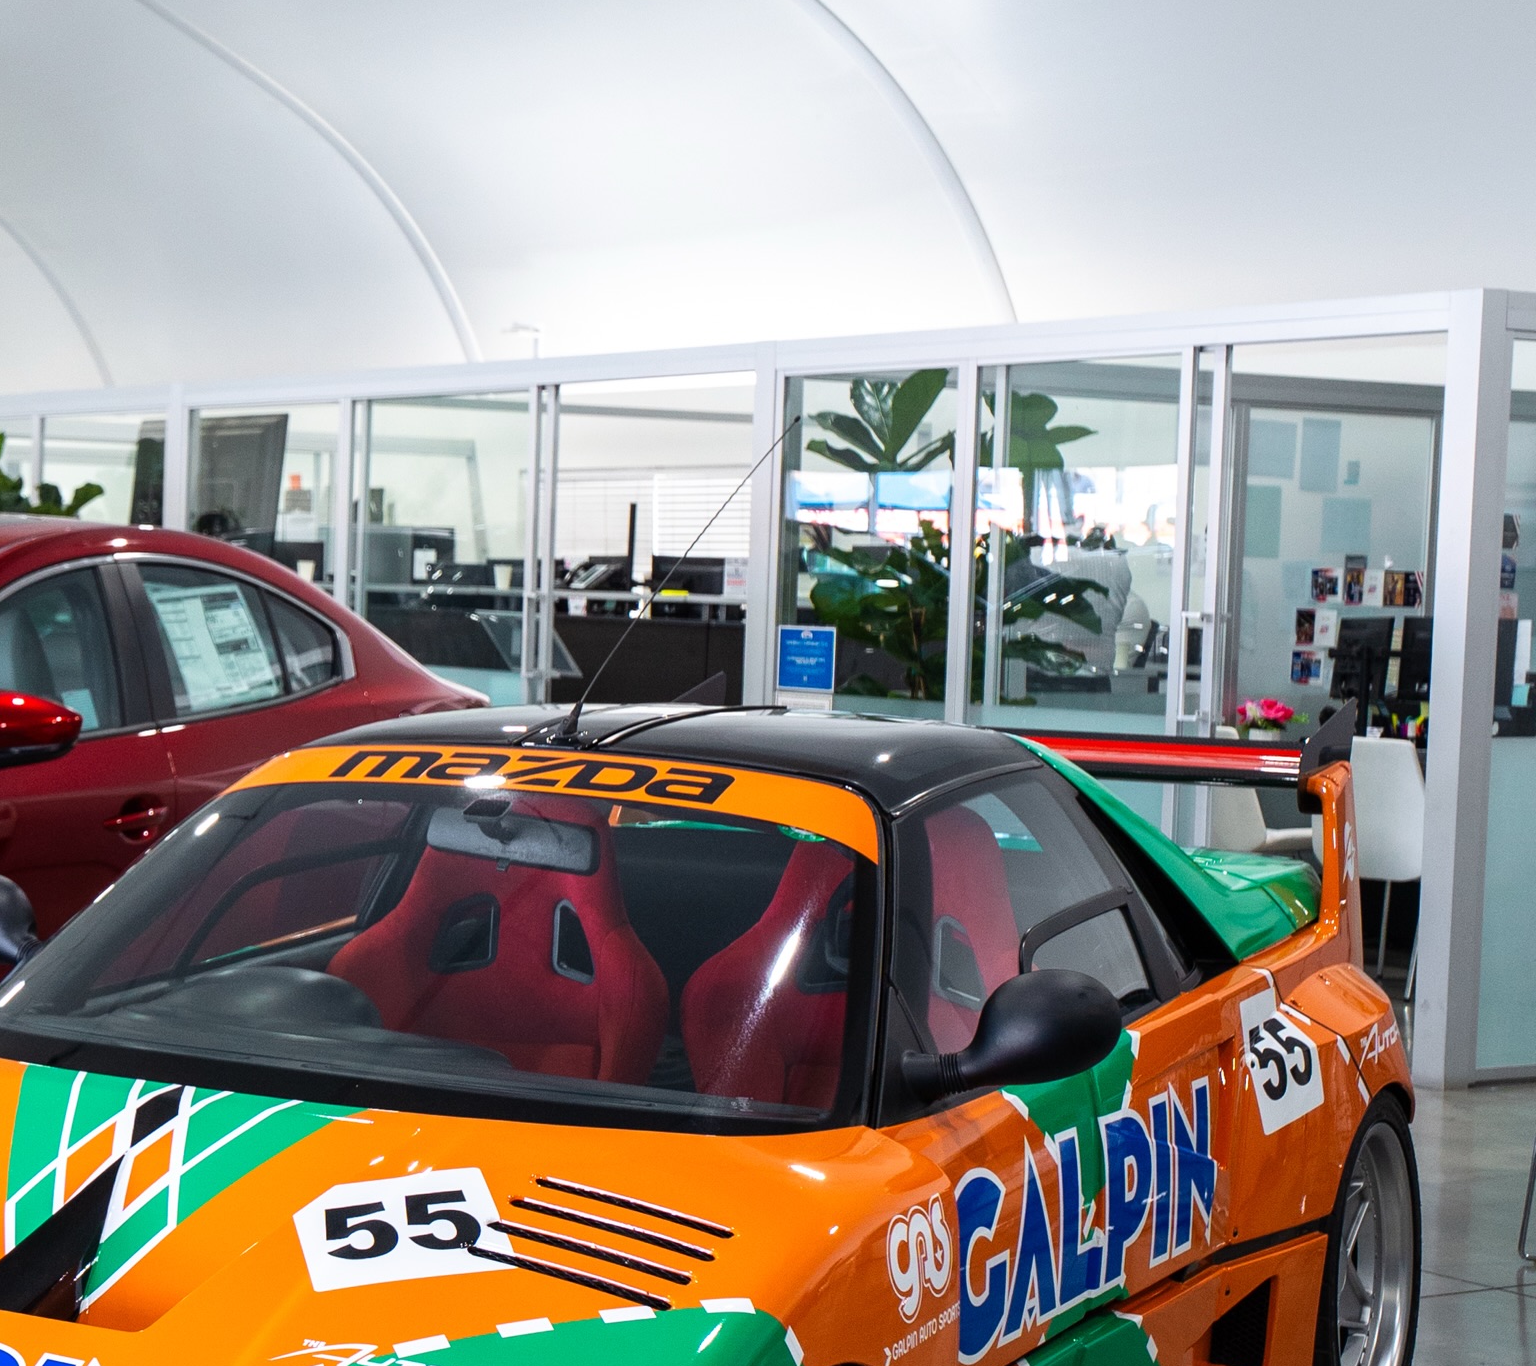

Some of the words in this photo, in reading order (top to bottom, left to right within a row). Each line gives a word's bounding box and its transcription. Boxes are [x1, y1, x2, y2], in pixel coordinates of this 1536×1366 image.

[1248, 1017, 1313, 1102] 55
[324, 1189, 482, 1260] 55
[955, 1075, 1217, 1366] GALPIN
[891, 1332, 919, 1362] GALPIN
[919, 1317, 938, 1343] AUTO
